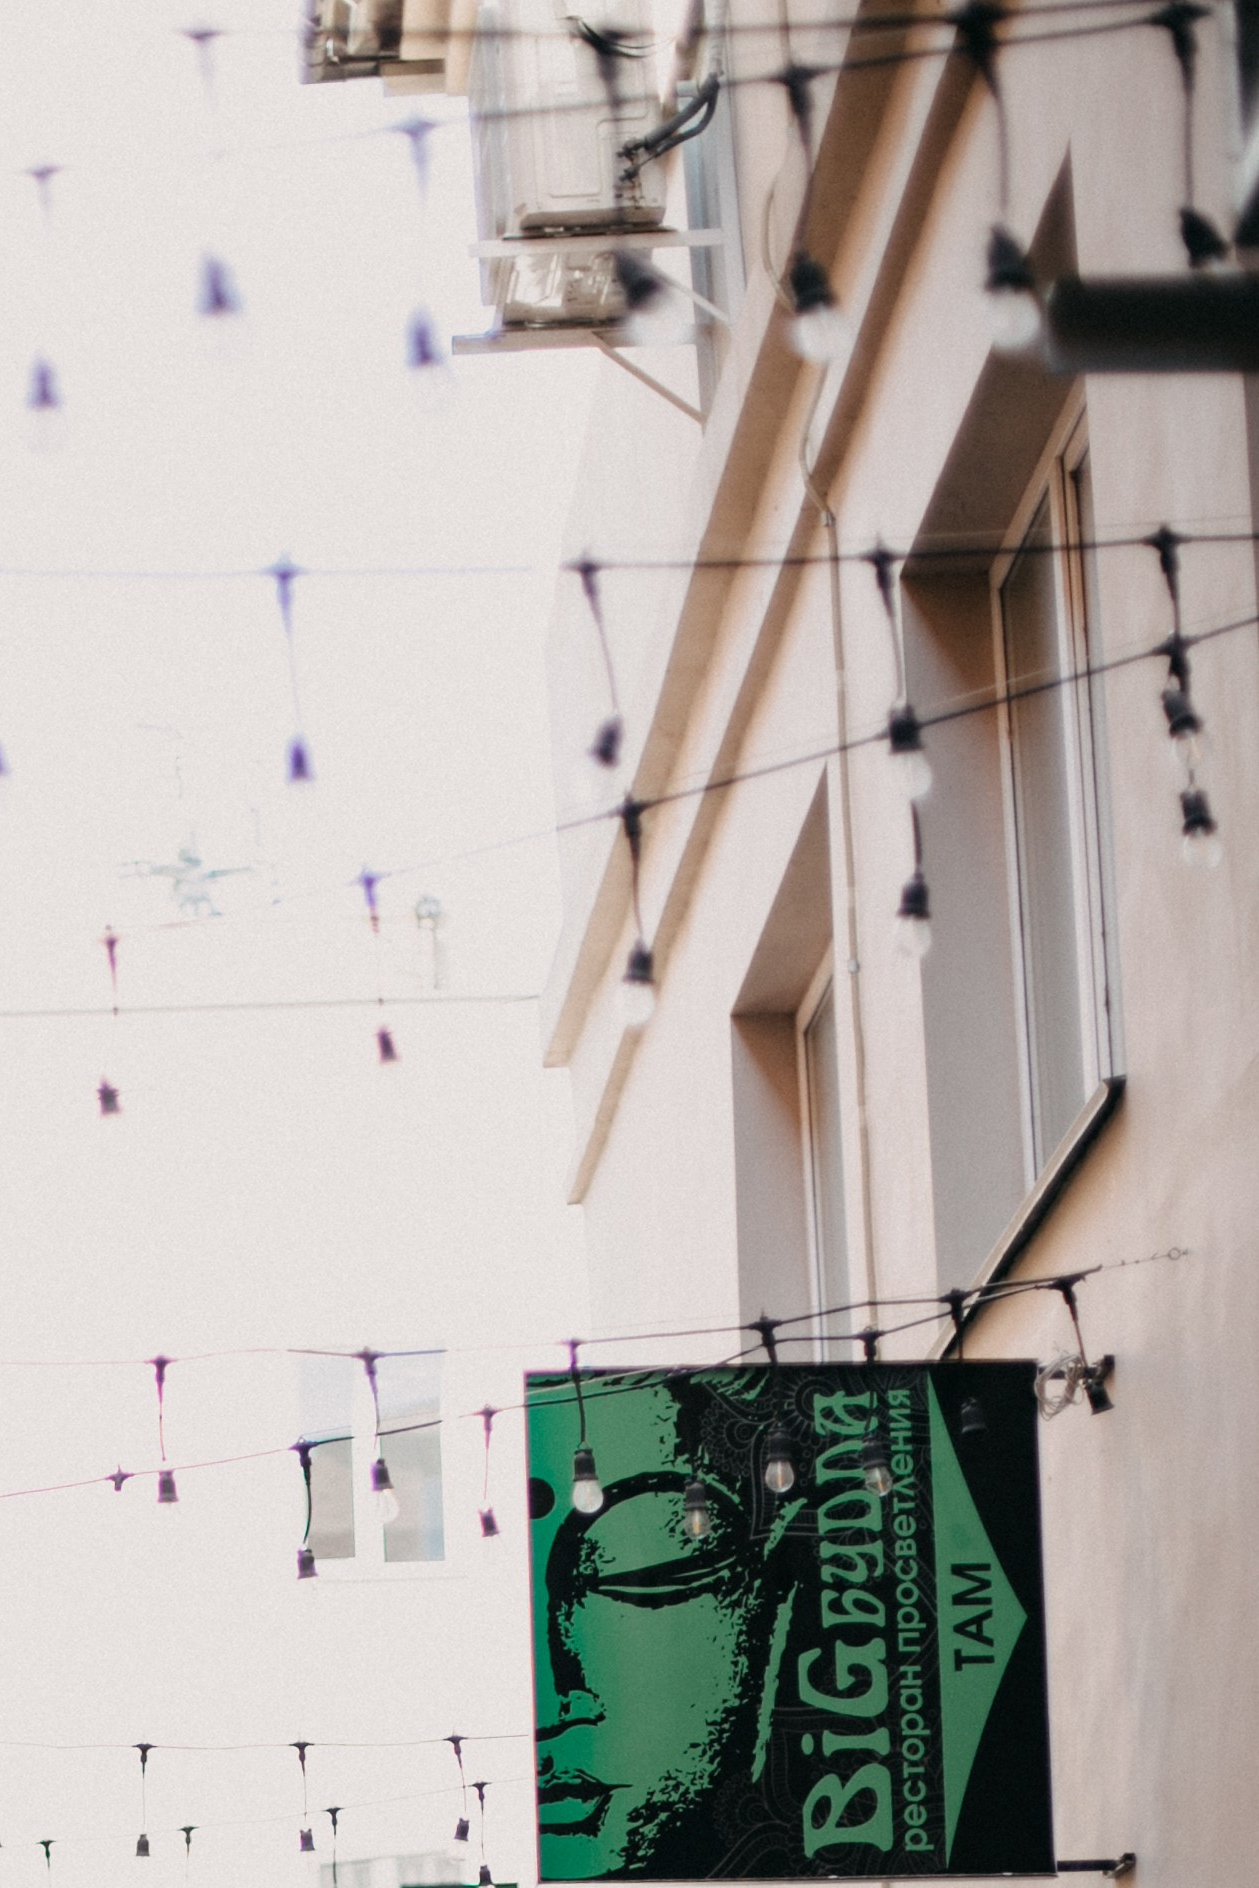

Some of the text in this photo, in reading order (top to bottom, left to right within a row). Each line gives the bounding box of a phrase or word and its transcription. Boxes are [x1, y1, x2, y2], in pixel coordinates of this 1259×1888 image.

[887, 1389, 934, 1853] ресторан просветления
[950, 1562, 995, 1672] ТАМ
